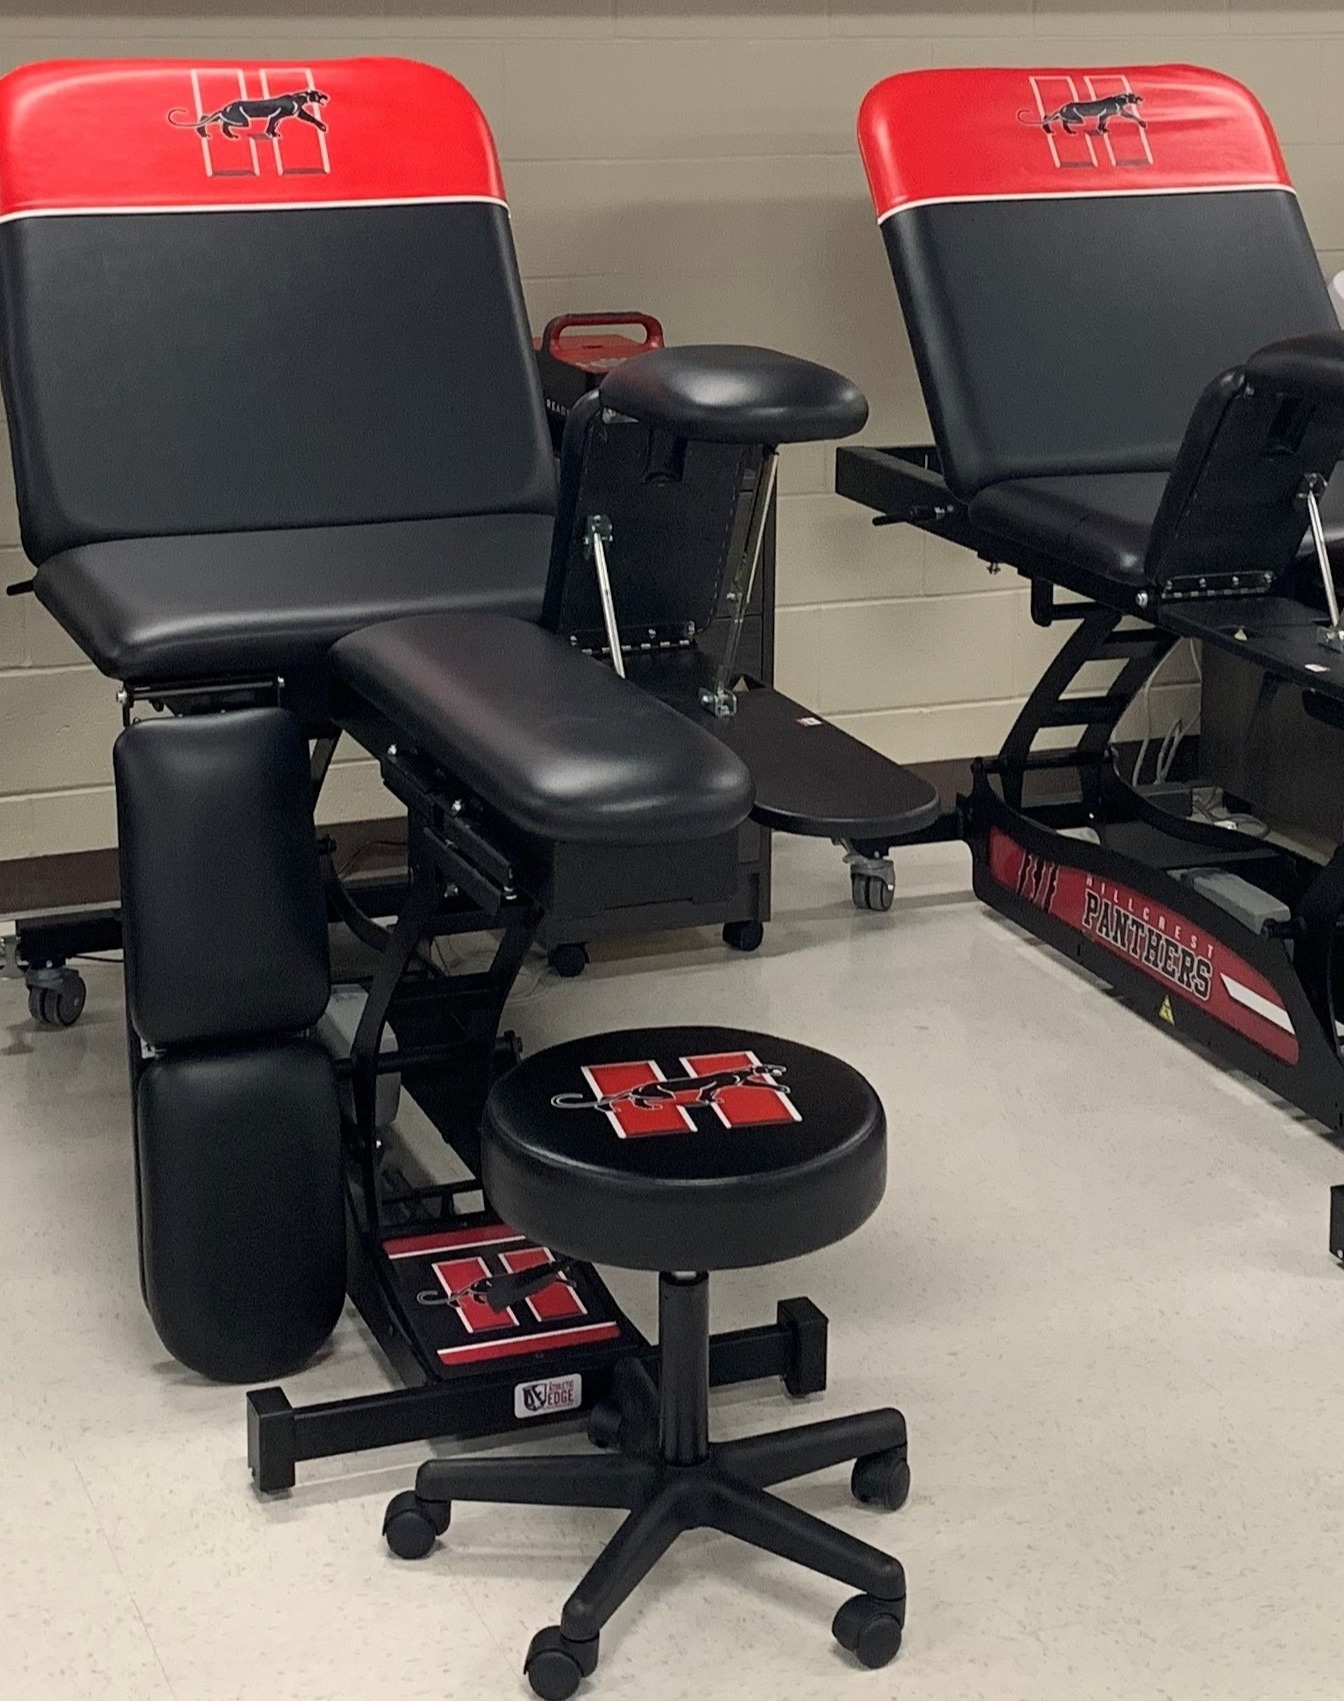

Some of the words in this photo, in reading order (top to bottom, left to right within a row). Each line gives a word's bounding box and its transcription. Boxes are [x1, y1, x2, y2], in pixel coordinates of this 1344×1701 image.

[1081, 887, 1213, 1001] PANTHERS
[1085, 873, 1214, 959] HILLCREST
[580, 1050, 803, 1139] H
[431, 1246, 589, 1334] H
[547, 1389, 574, 1405] EDGE
